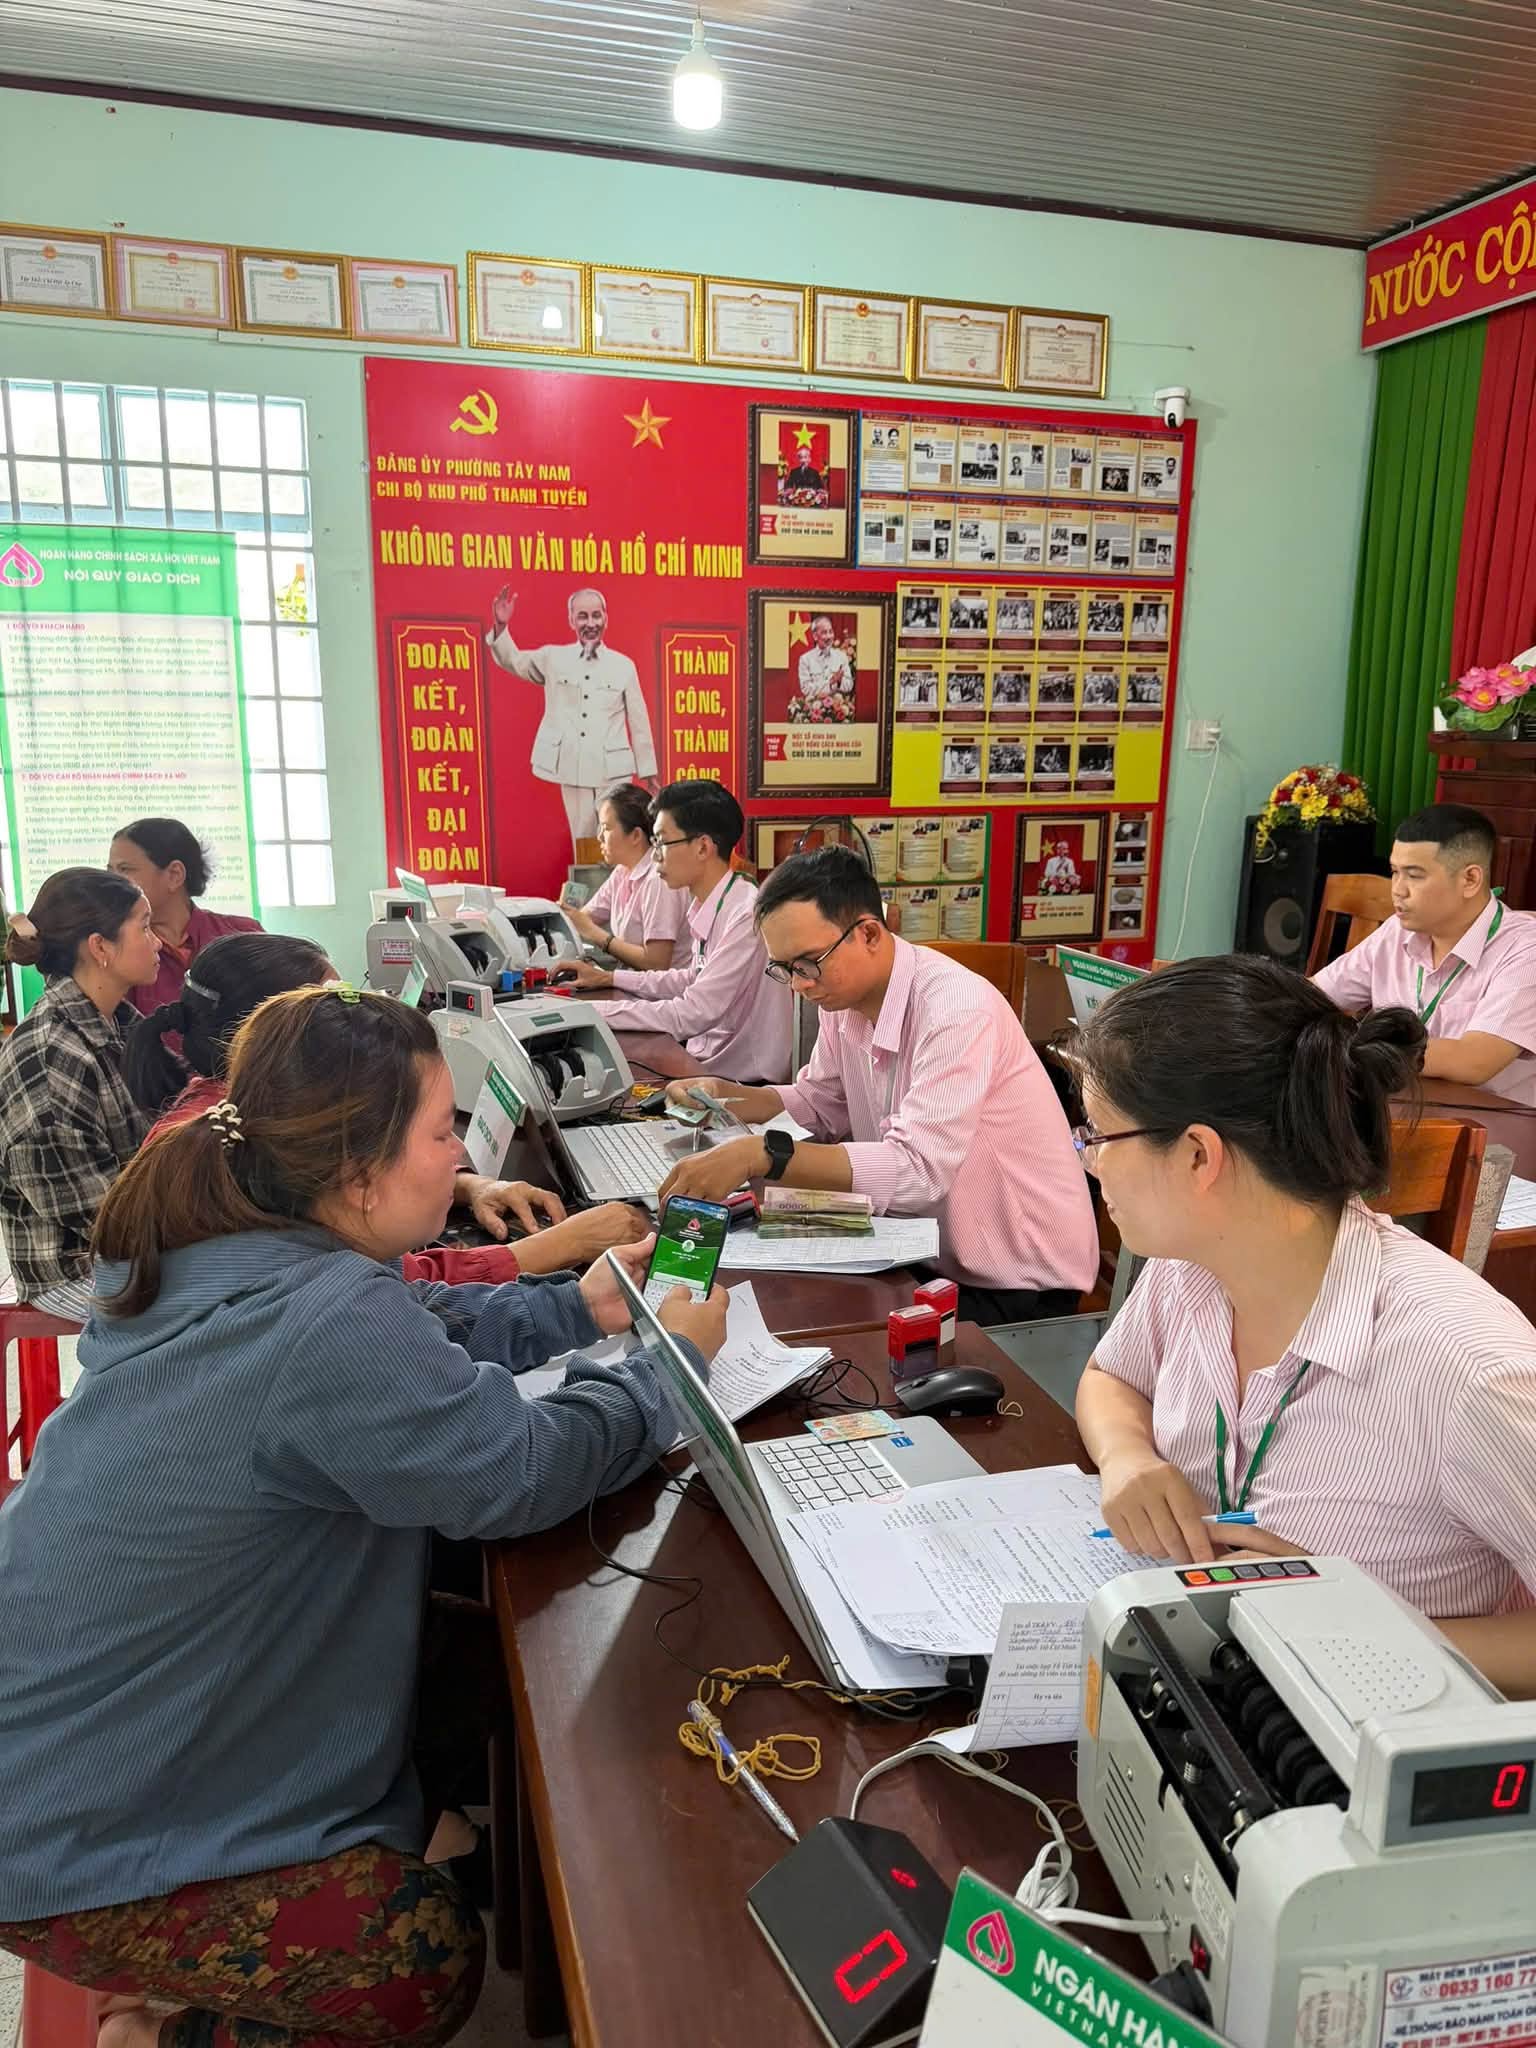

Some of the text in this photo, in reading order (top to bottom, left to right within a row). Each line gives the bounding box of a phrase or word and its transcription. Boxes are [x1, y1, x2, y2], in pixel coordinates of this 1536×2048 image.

[1366, 200, 1536, 326] NƯỚC CỘ
[377, 452, 571, 481] ĐẢNG ỦY PHƯỜNG TÂY NAM
[377, 481, 399, 497] CHI
[404, 480, 422, 501] BỘ
[428, 484, 456, 500] KHU
[461, 482, 488, 501] PHỐ
[493, 487, 537, 504] THANH
[380, 524, 743, 579] KHÔNG GIAN VĂN HÓA HỒ CHÍ MINH
[406, 638, 471, 671] ĐOÀN
[672, 645, 729, 675] THÀNH
[413, 678, 466, 715] KẾT,
[675, 685, 726, 718] CÔNG,
[411, 722, 474, 752] ĐOÀN
[673, 724, 729, 753] THÀNH
[417, 760, 470, 796] KẾT,
[426, 807, 467, 837] ĐẠI
[418, 842, 480, 872] ĐOÀN
[468, 995, 474, 1009] 0
[1492, 1764, 1526, 1808] 0
[833, 1929, 908, 2004] 0
[1034, 1948, 1191, 2048] NGÂN HÀ
